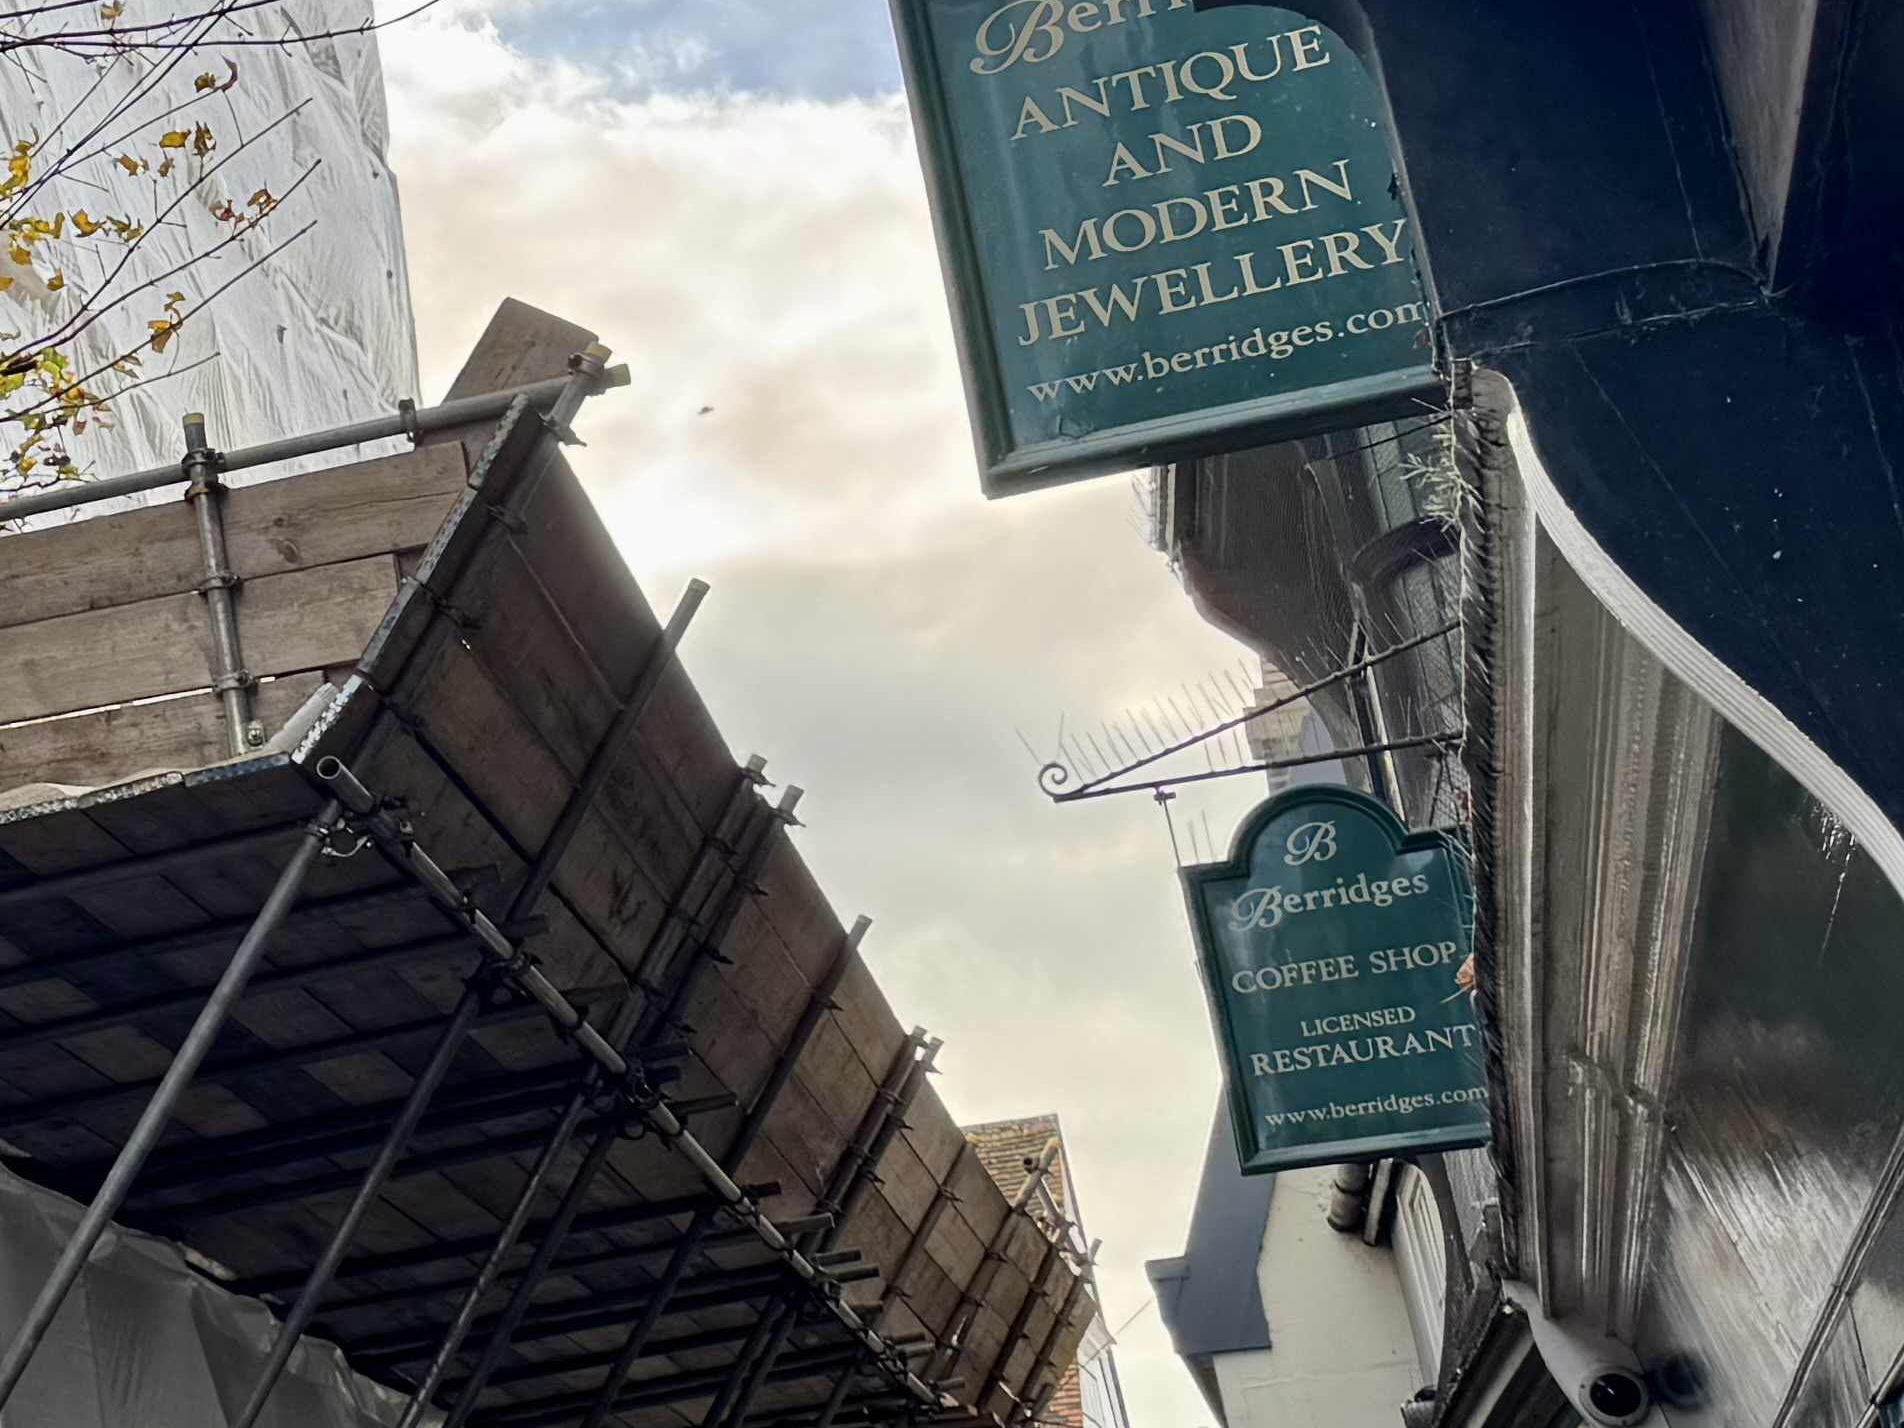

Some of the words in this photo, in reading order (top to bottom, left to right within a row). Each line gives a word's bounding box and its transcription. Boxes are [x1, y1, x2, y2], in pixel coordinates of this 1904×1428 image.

[1010, 25, 1332, 141] ANTIQUE
[1103, 114, 1263, 187] AND
[1039, 160, 1353, 271] MODERN
[1018, 219, 1407, 347] JEWELLERY
[1026, 301, 1427, 402] www.berridges.com
[1283, 820, 1338, 867] B
[1228, 872, 1430, 933] Berridges
[1232, 955, 1360, 995] COFFEE
[1369, 940, 1458, 975] SHOP
[1250, 1024, 1476, 1077] RESTAURANT
[1300, 1006, 1417, 1037] LICENSED
[1265, 1086, 1489, 1127] www.berridges.com
